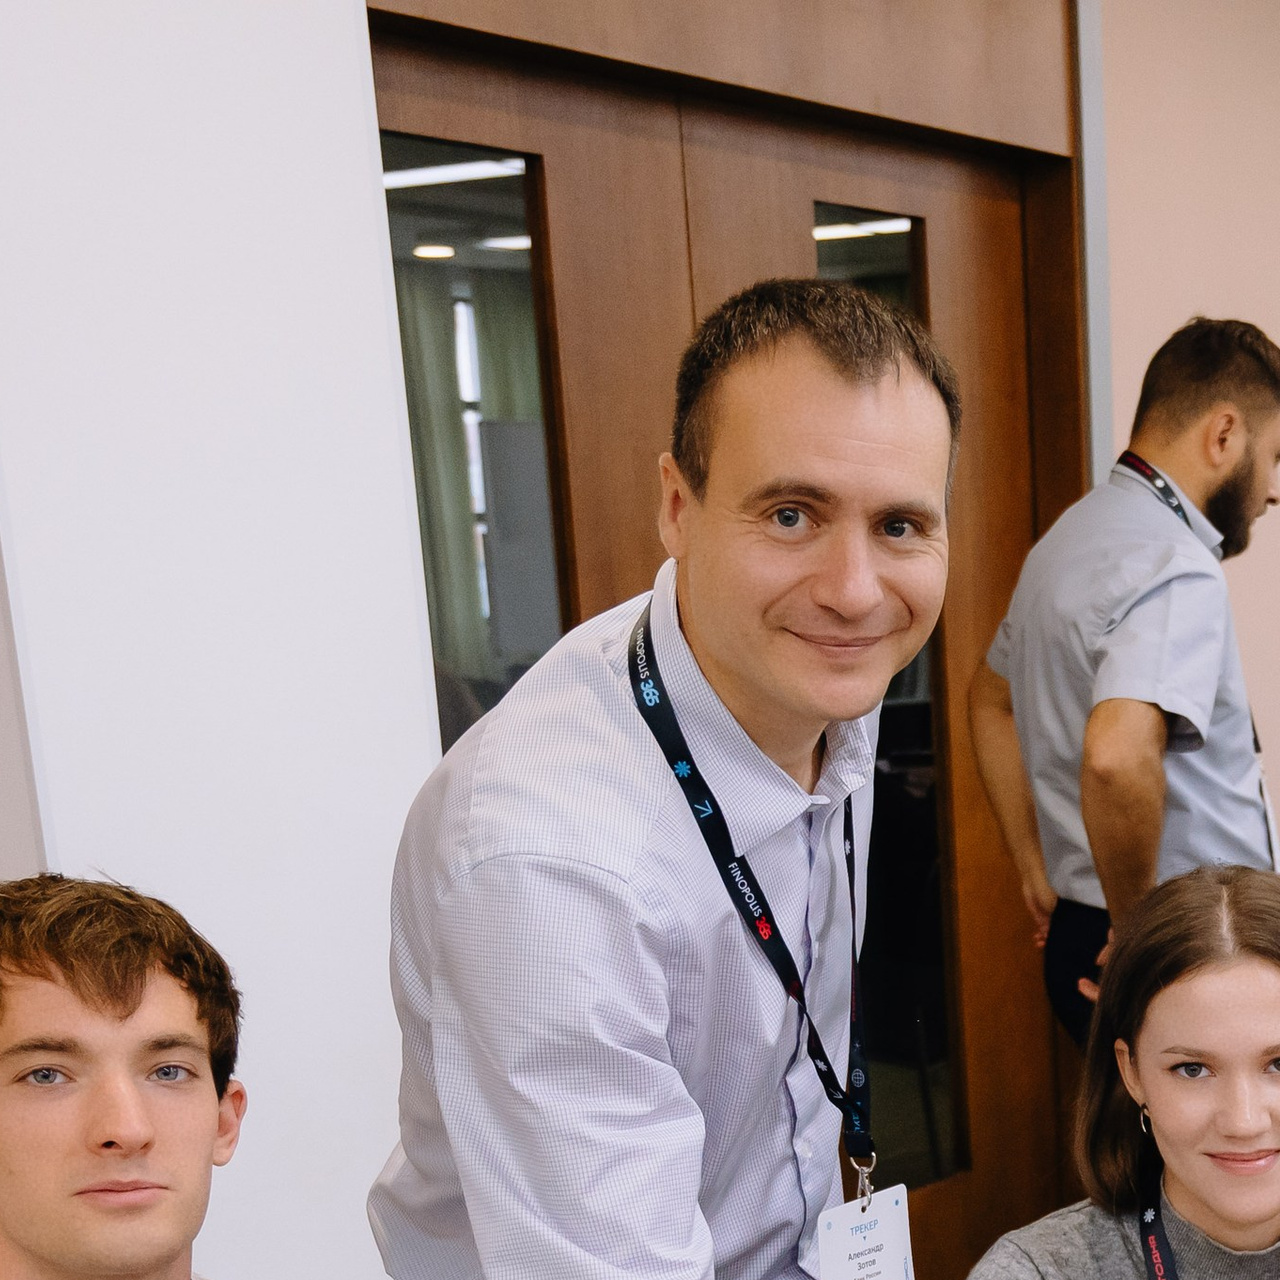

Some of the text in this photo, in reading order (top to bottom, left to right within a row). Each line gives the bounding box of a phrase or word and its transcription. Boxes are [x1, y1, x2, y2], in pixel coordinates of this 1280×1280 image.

[637, 627, 660, 707] FINOPOLIS 365
[728, 862, 772, 941] FINOPOLIS 365
[850, 1219, 879, 1236] ТРЕКЕР
[848, 1243, 884, 1262] Александр
[857, 1259, 877, 1271] Зотов
